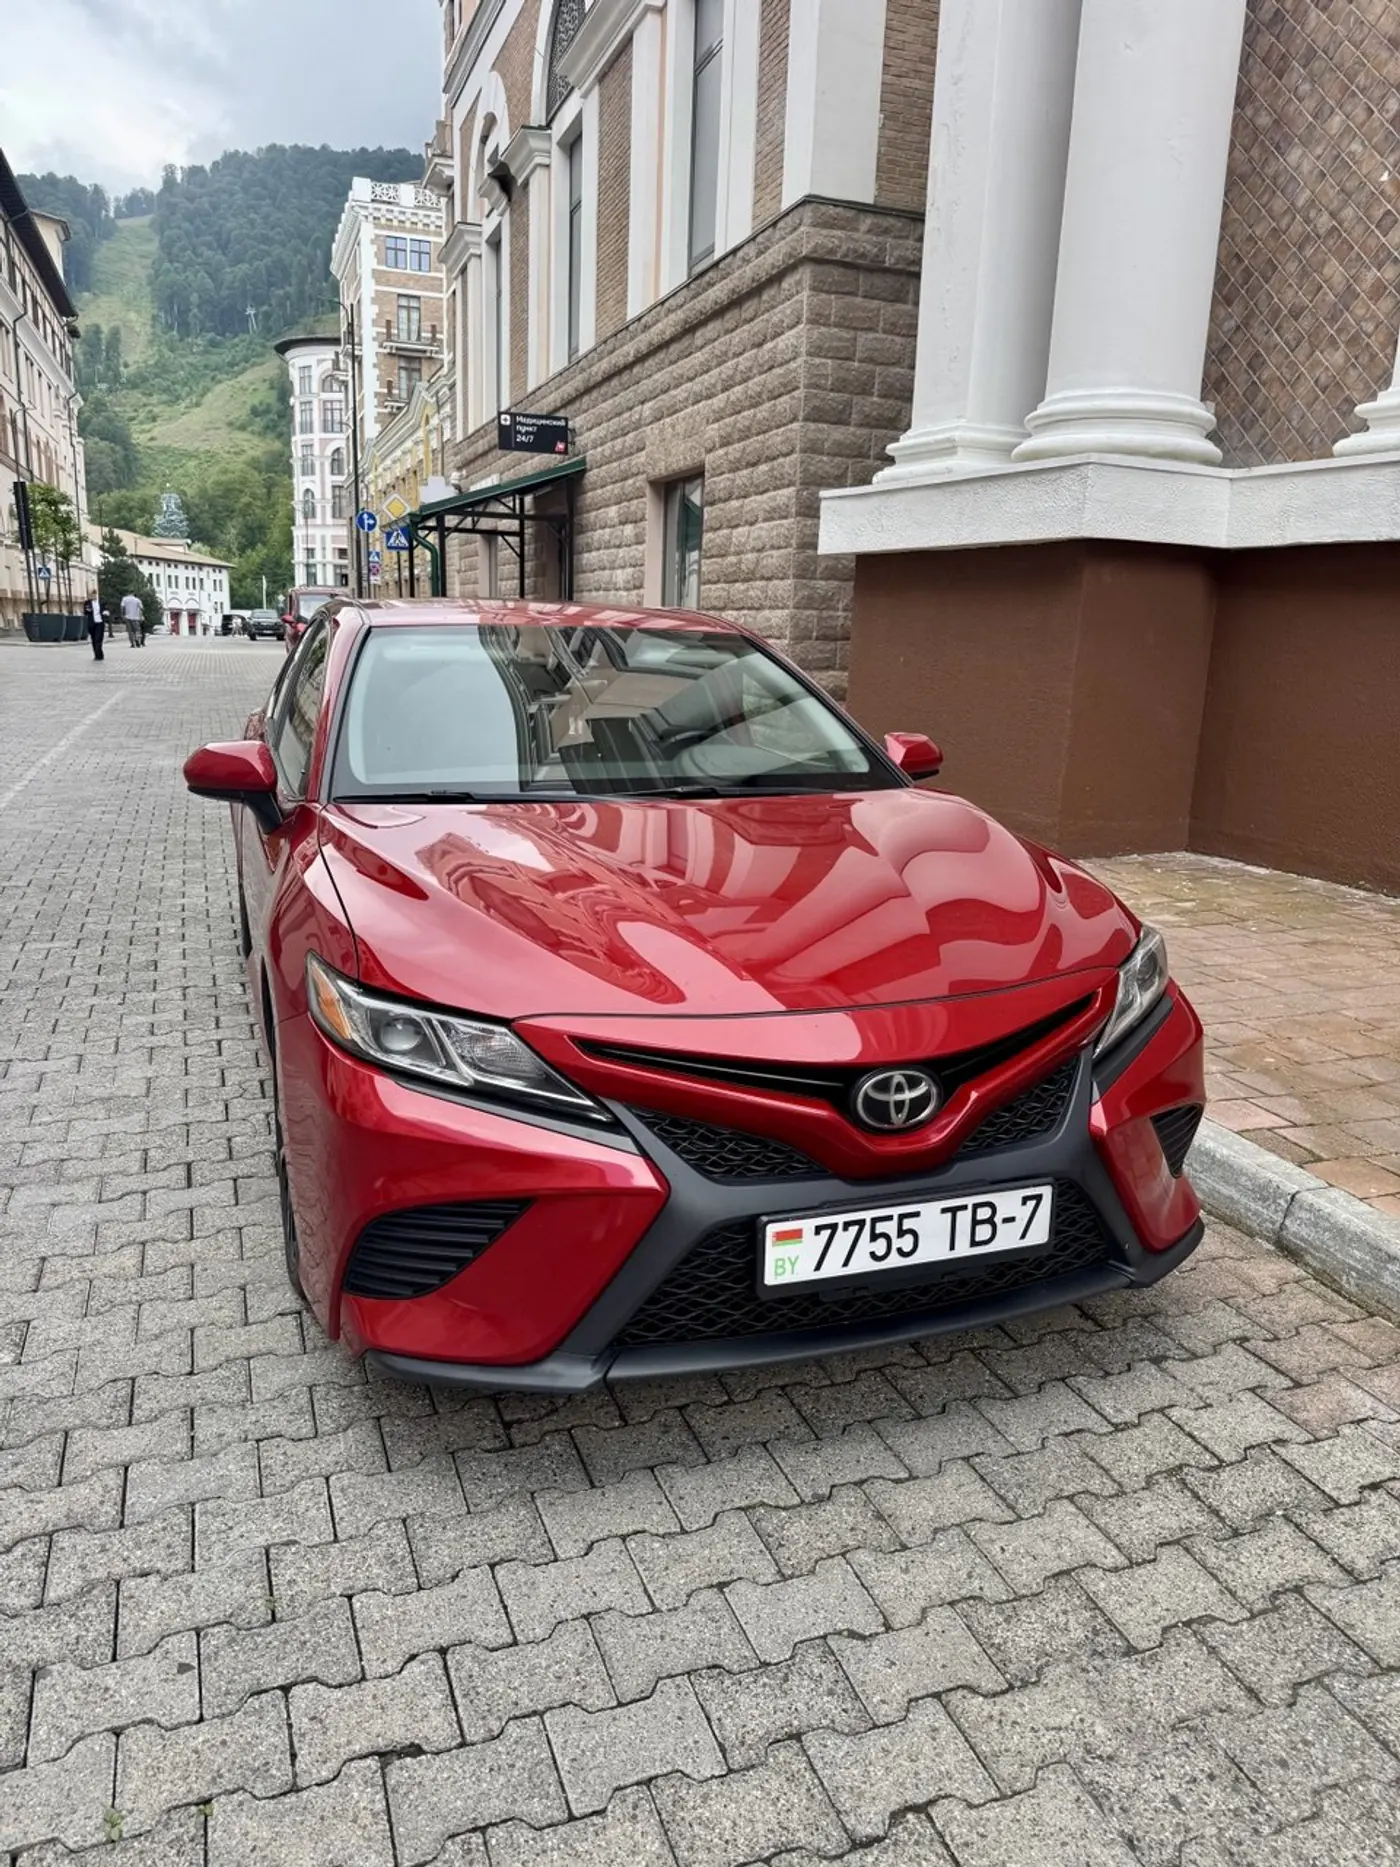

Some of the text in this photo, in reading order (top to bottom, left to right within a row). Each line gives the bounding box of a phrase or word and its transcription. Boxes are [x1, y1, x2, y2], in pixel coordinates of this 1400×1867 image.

[516, 434, 534, 443] 24/7
[813, 1194, 1044, 1272] 7755 TB-7
[774, 1255, 799, 1277] BY
